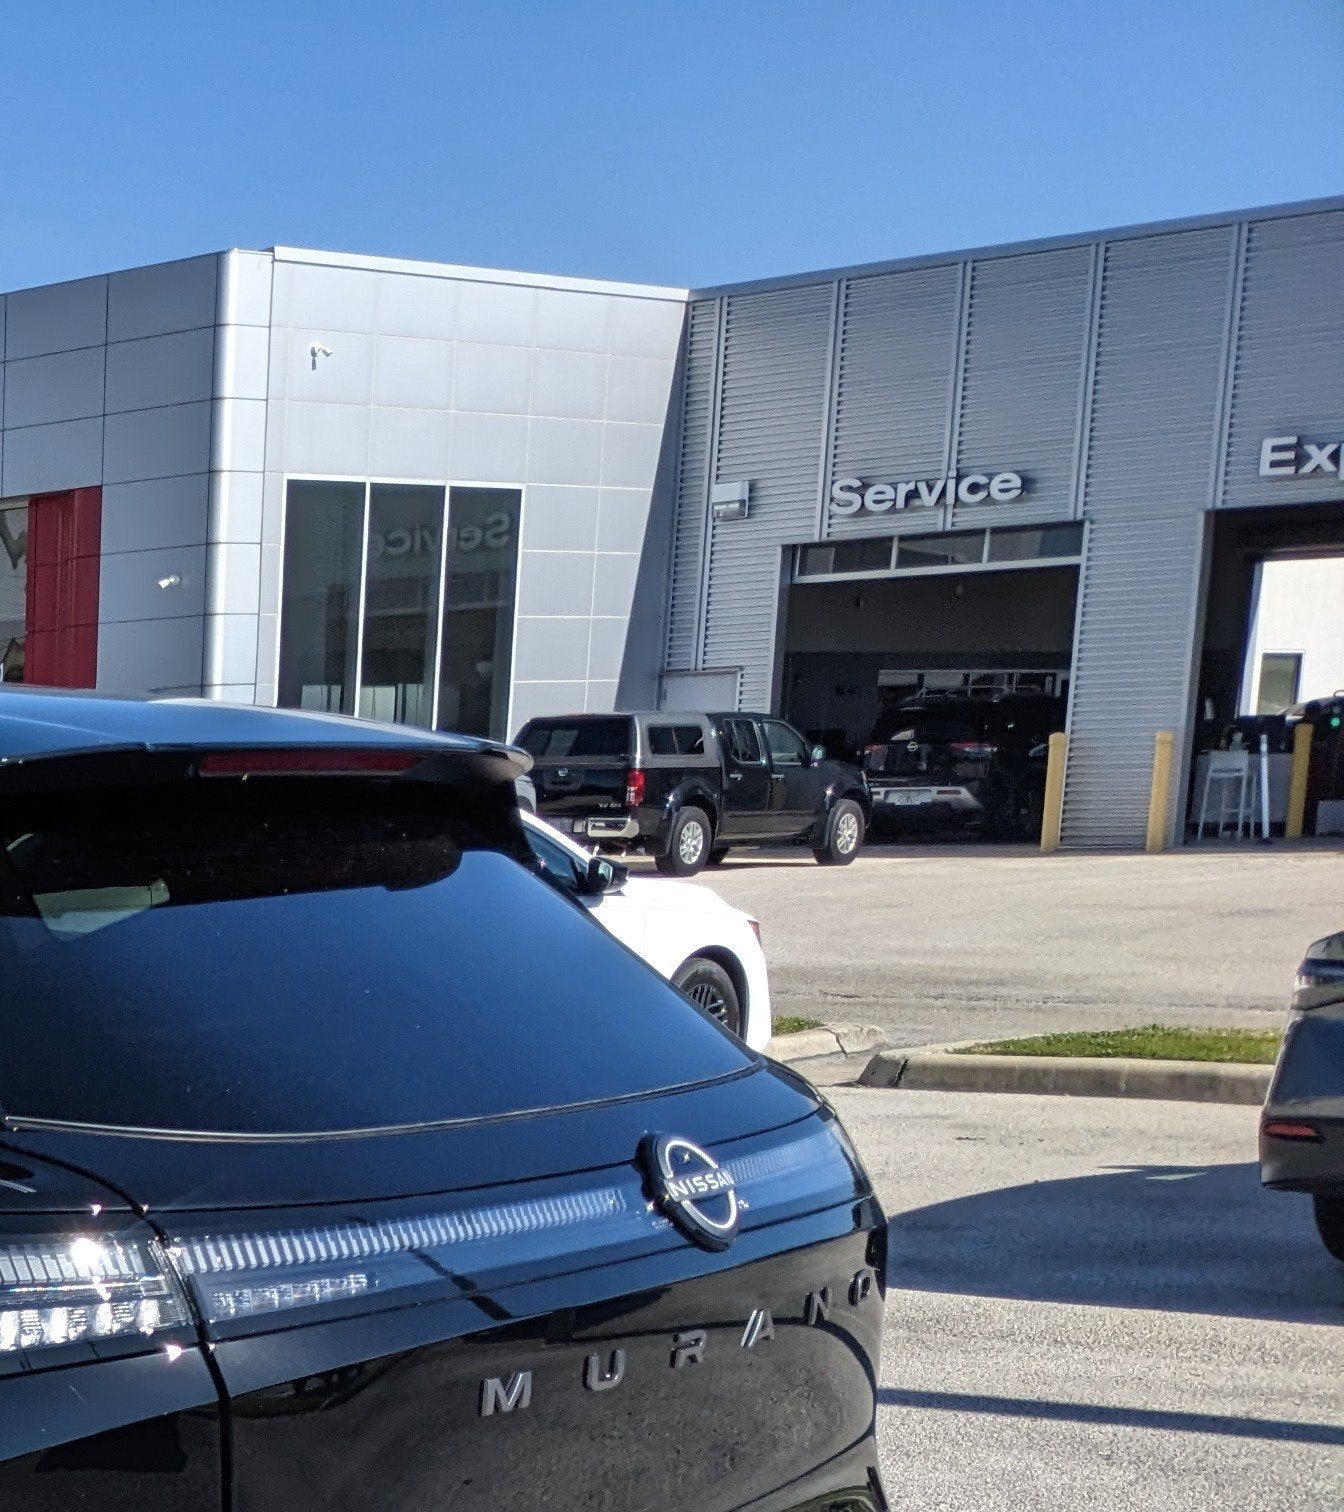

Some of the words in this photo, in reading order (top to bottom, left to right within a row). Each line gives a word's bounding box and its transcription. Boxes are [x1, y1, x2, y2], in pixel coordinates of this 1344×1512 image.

[1258, 435, 1344, 480] Ex
[829, 470, 1022, 515] Service
[668, 1170, 734, 1198] NISSAN
[480, 1268, 875, 1417] MURANO
